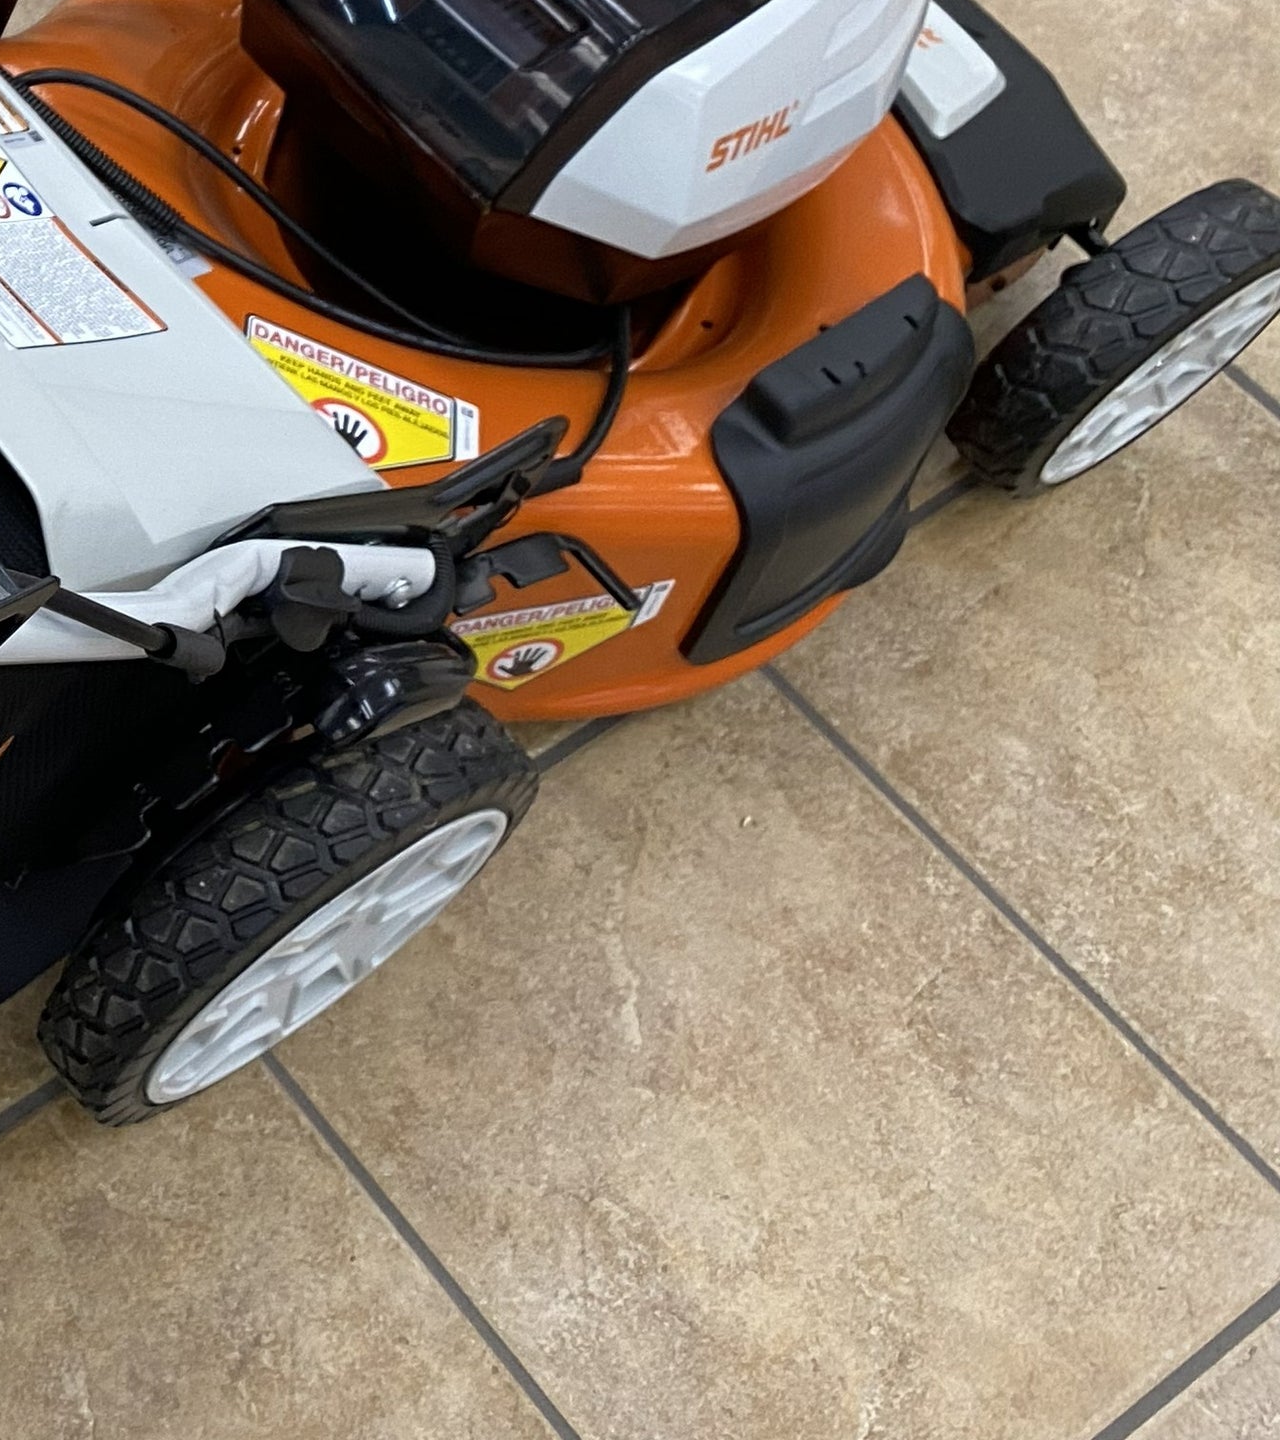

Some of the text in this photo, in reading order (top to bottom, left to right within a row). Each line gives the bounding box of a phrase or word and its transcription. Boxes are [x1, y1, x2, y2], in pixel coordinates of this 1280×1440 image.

[705, 106, 792, 173] STIHL
[254, 323, 448, 416] DANGER/PELIGRO
[454, 594, 620, 636] DANGER/PELIG
